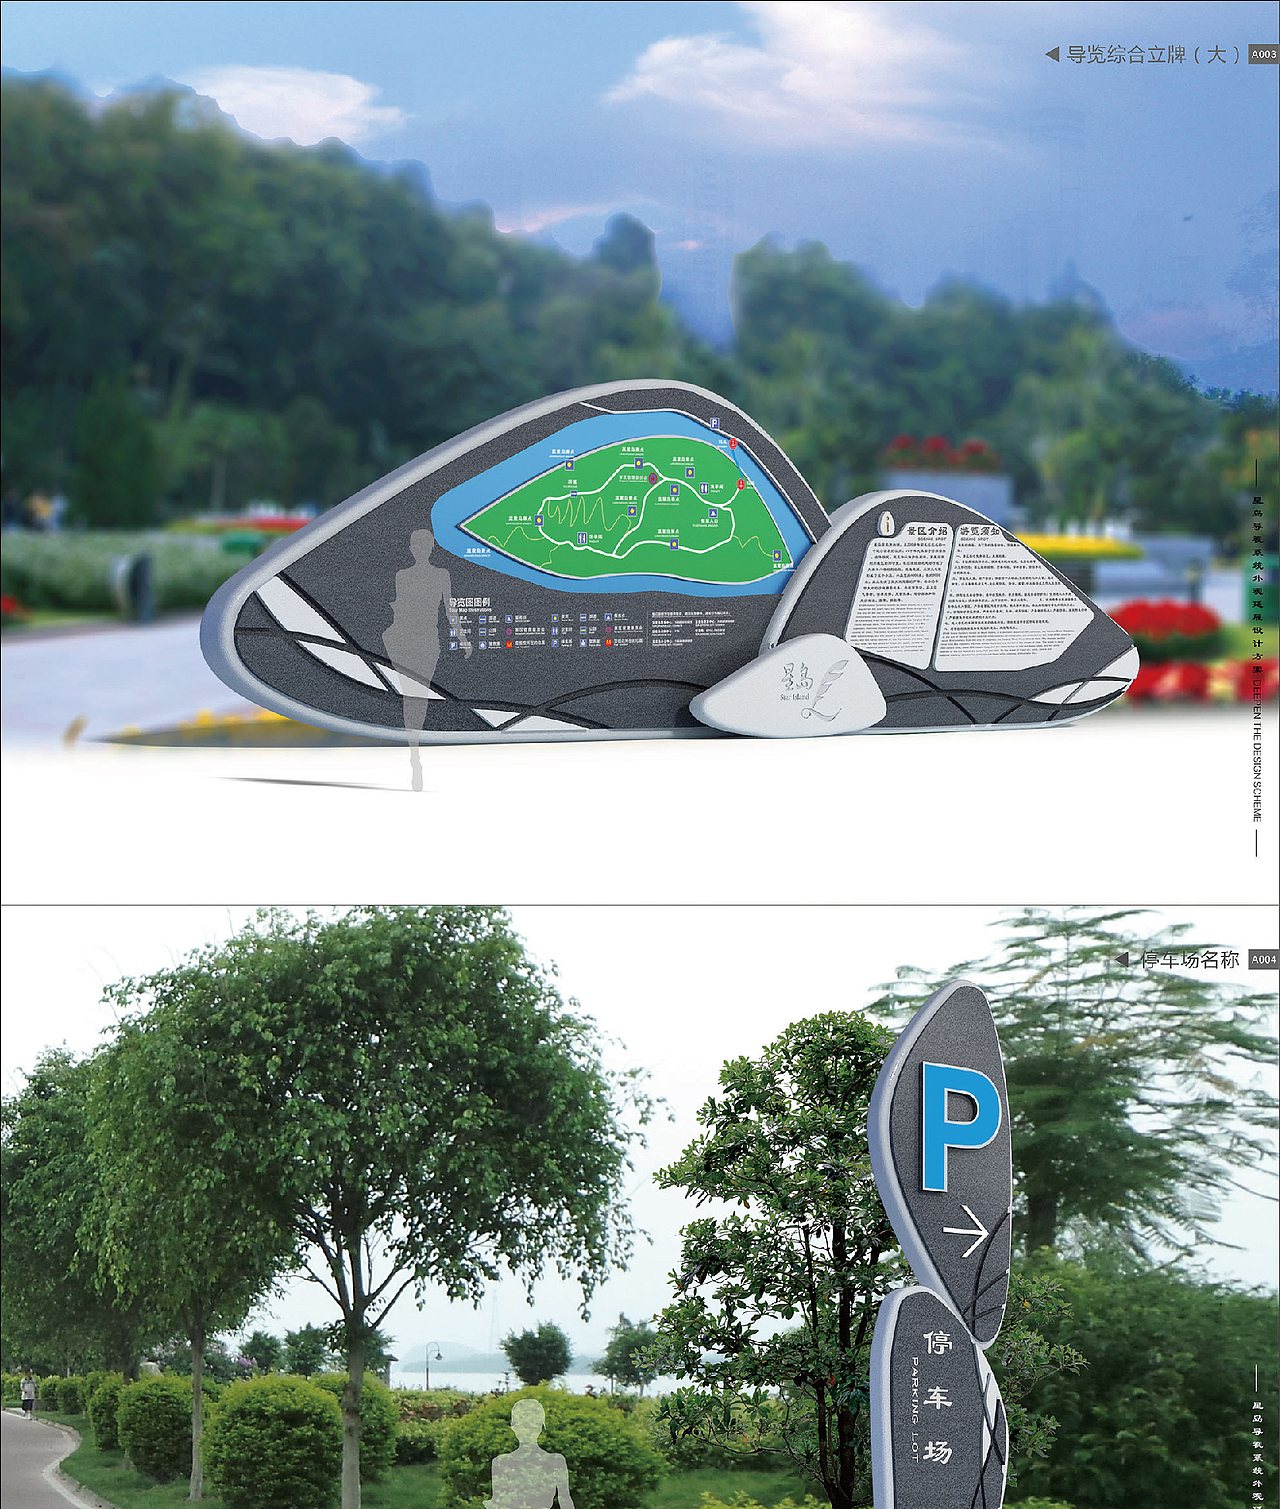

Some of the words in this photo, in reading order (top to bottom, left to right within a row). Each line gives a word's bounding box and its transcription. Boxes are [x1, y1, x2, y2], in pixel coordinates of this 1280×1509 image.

[907, 526, 948, 536] 景区介绍
[960, 526, 1000, 536] 游览须知
[921, 1062, 1002, 1193] P
[911, 1357, 919, 1425] PARKING
[922, 1330, 953, 1465] 停车场
[911, 1433, 919, 1463] LOT
